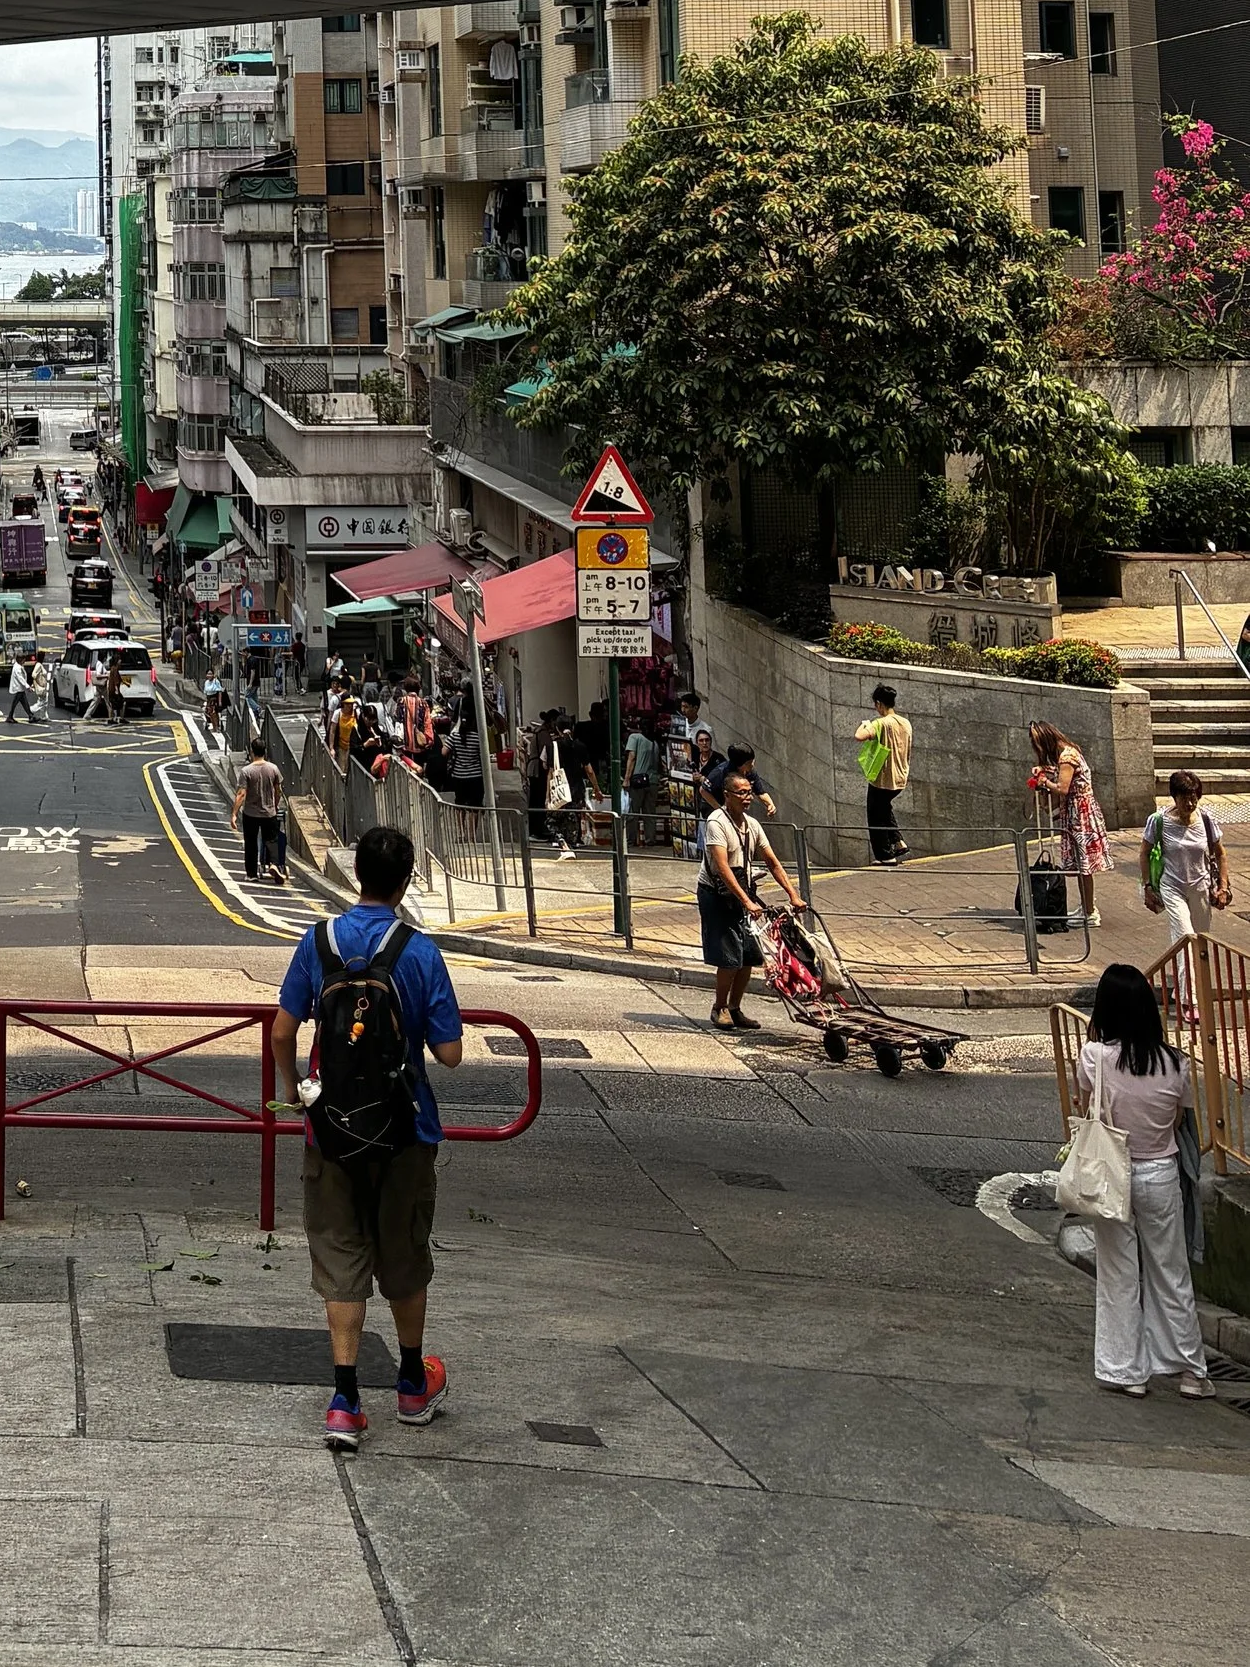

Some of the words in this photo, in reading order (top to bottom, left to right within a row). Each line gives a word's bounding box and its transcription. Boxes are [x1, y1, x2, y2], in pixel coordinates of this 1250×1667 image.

[603, 481, 624, 499] 1:8
[347, 517, 410, 537] 中國銀行
[606, 576, 646, 591] 8-10
[838, 556, 944, 594] ISLAND
[954, 566, 1057, 605] CREST
[582, 582, 602, 592] 上午
[583, 605, 603, 615] 下午
[595, 628, 621, 636] Except
[586, 636, 602, 644] pick
[603, 636, 632, 644] up/drop
[582, 645, 648, 655] 的士上落客除外
